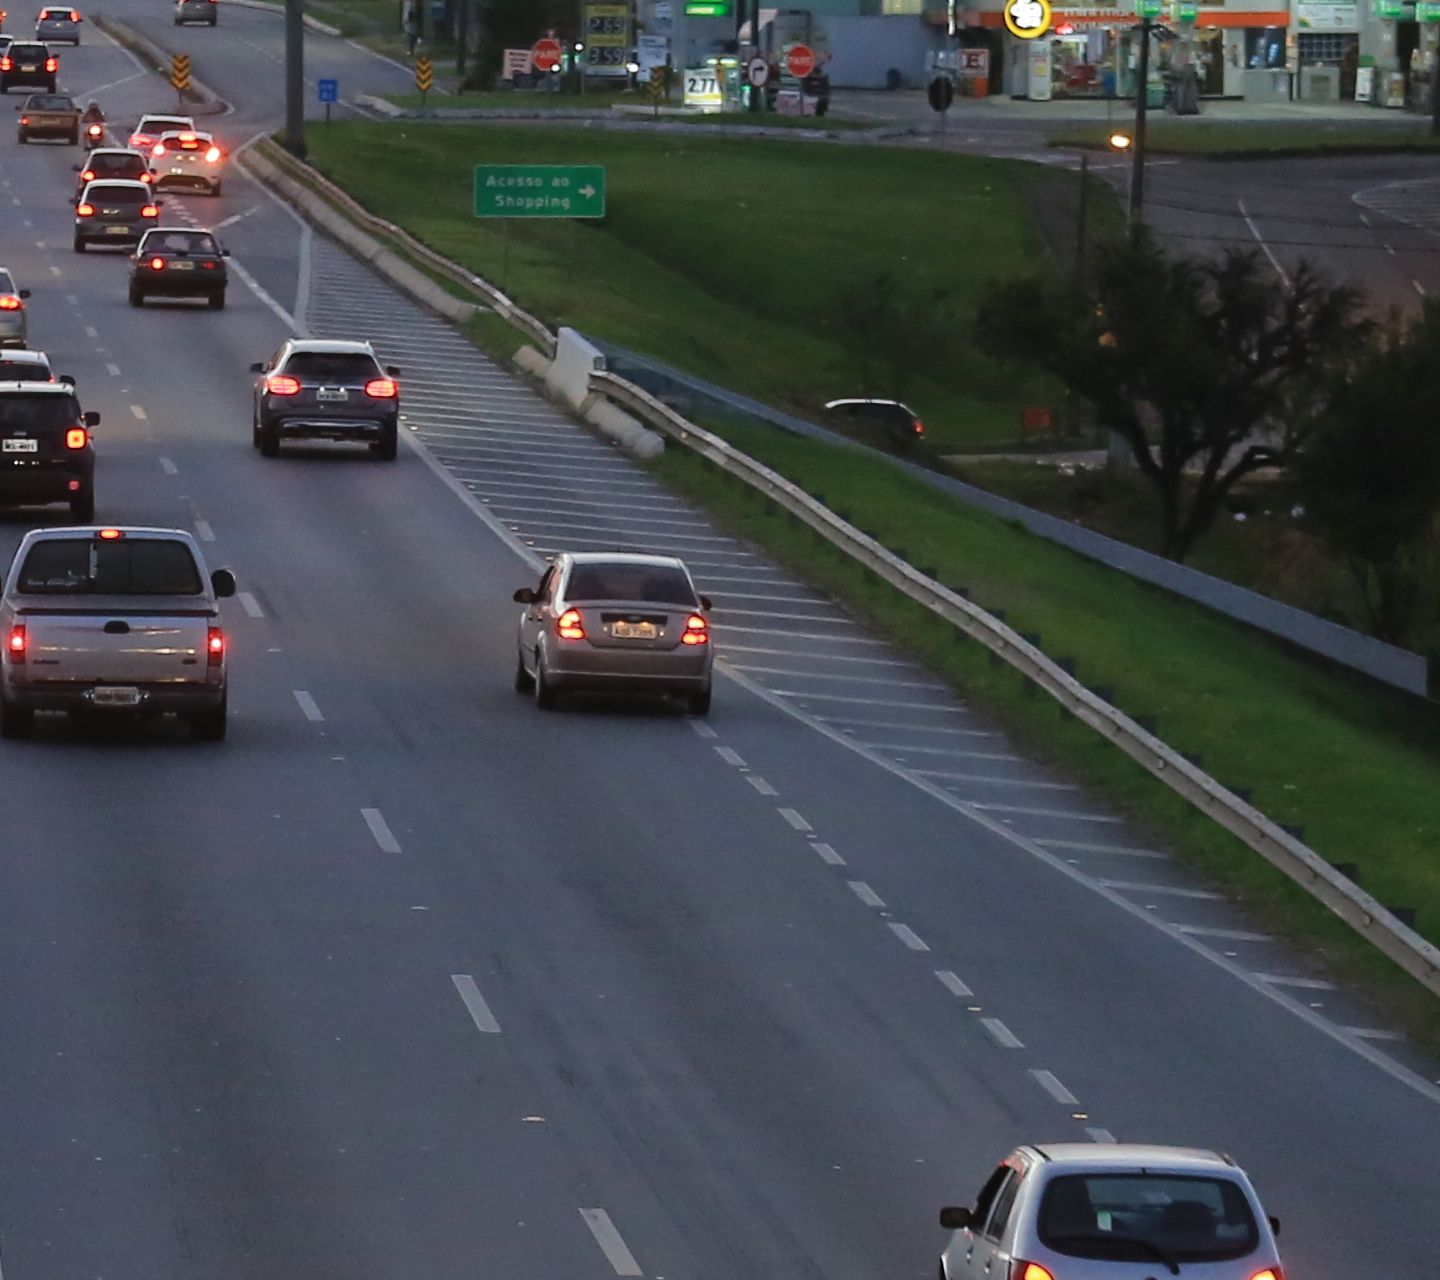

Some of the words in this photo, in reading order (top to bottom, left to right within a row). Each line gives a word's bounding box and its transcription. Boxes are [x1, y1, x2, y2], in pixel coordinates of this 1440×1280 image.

[534, 50, 560, 60] PARE
[486, 176, 543, 187] Acesso
[551, 177, 570, 187] ao
[495, 195, 571, 210] Shopping
